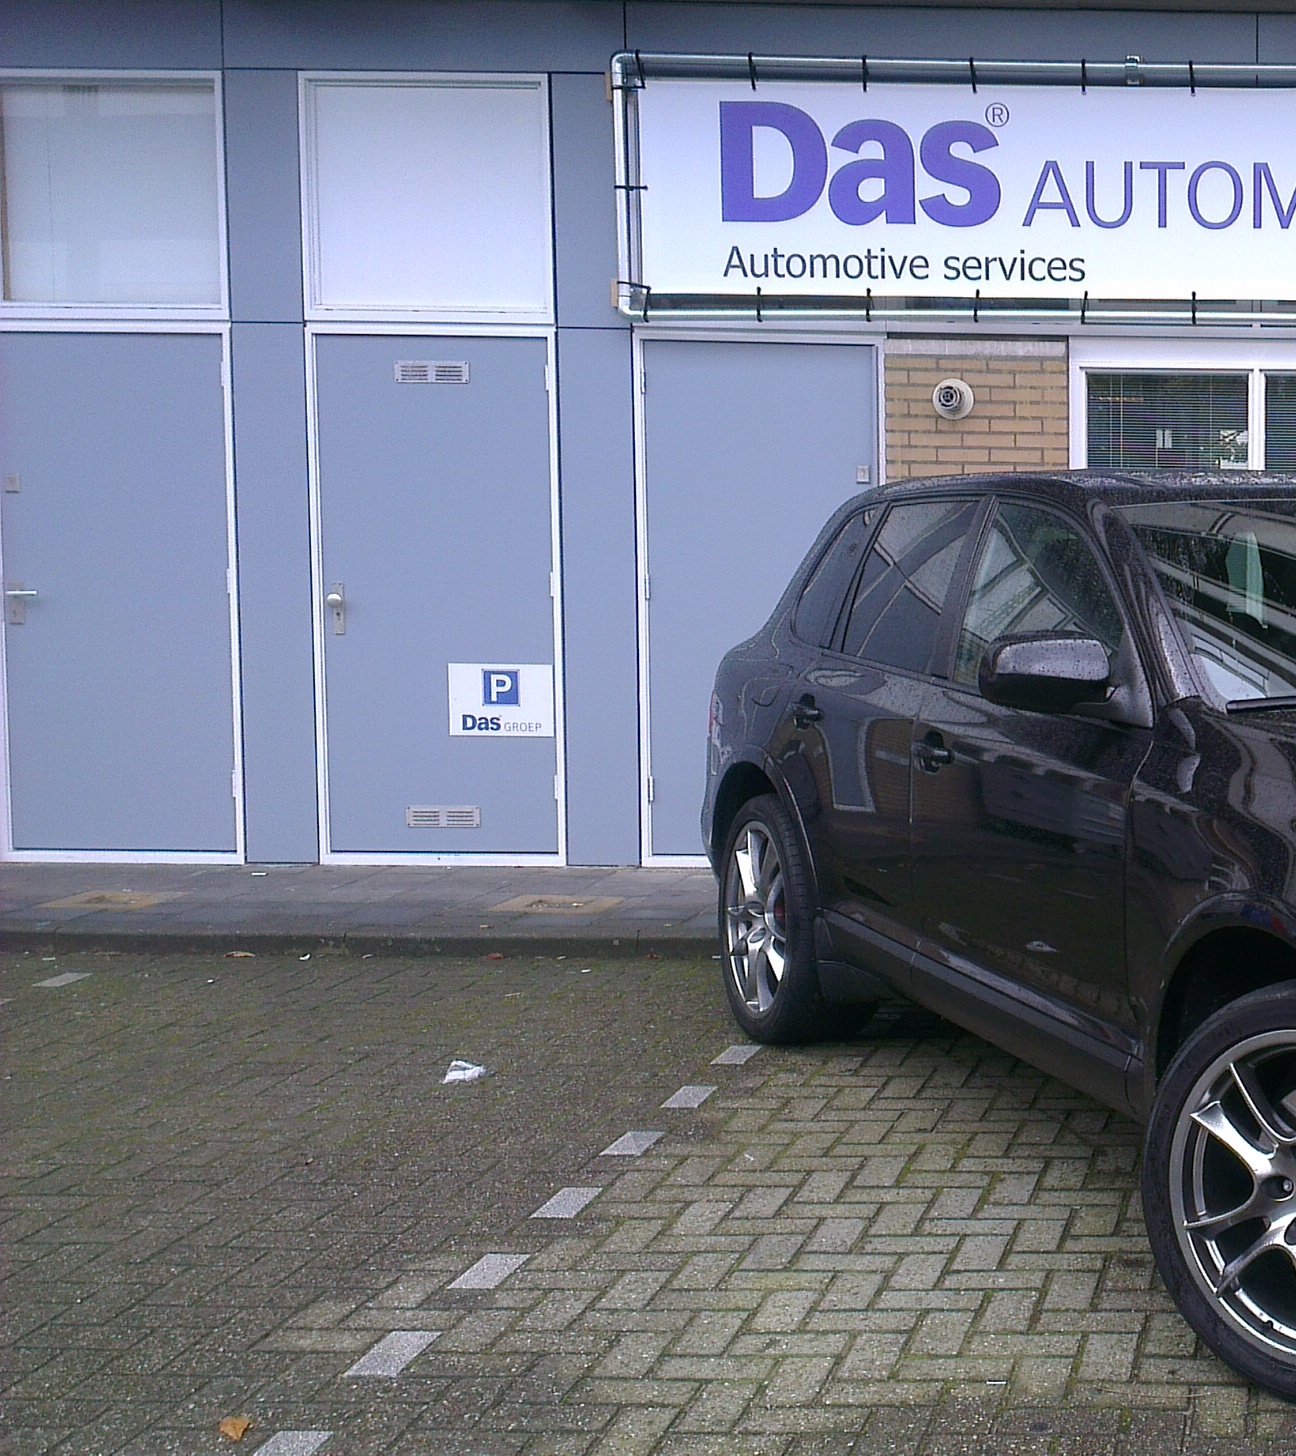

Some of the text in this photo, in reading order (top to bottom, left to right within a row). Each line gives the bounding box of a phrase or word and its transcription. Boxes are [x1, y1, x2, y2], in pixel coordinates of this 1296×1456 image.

[723, 245, 1086, 282] Automotive services
[490, 674, 512, 702] P
[462, 714, 542, 732] Das GROEP
